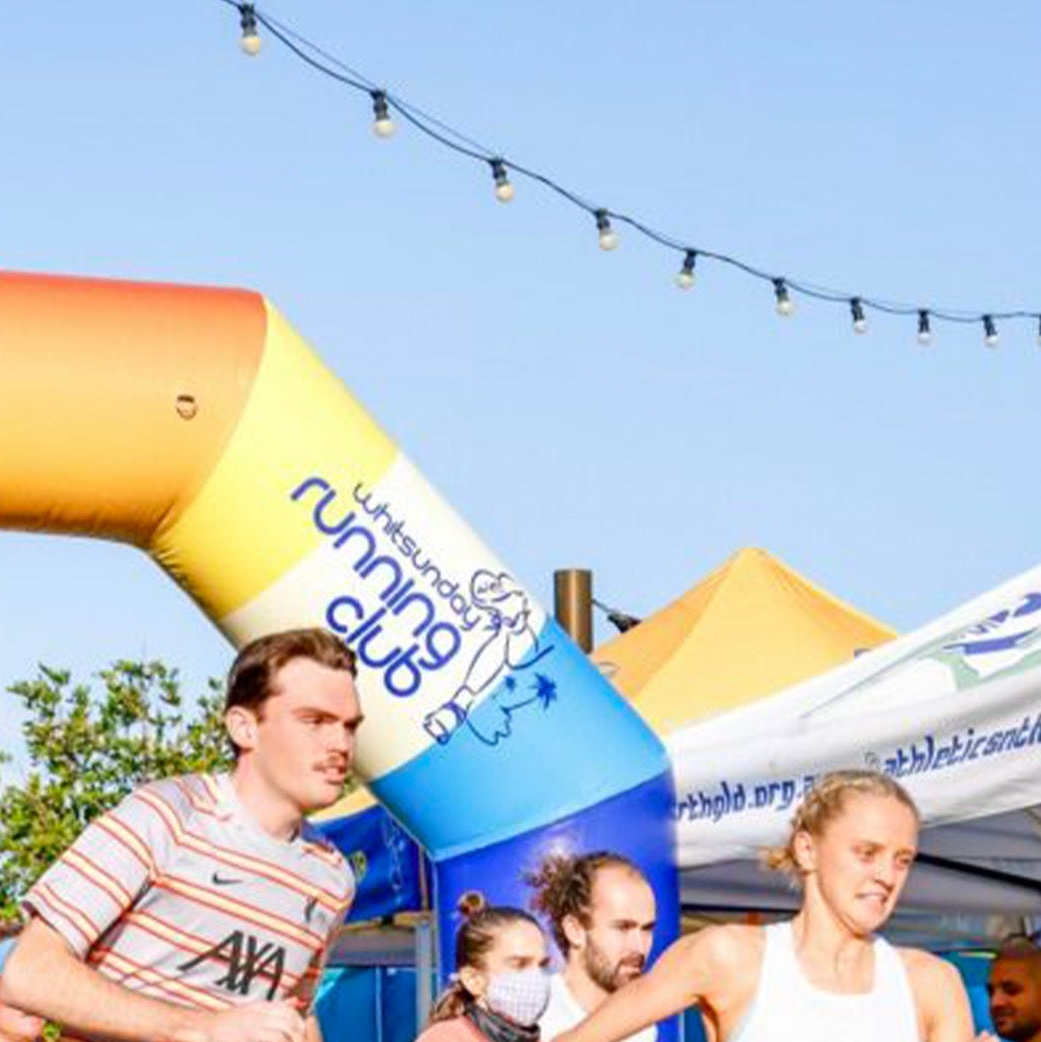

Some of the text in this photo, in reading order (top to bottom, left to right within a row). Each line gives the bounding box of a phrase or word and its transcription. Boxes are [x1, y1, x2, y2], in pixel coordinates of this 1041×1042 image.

[290, 476, 462, 671] running
[353, 481, 481, 633] whitsunday
[326, 595, 421, 698] club
[178, 930, 289, 1001] AXA
